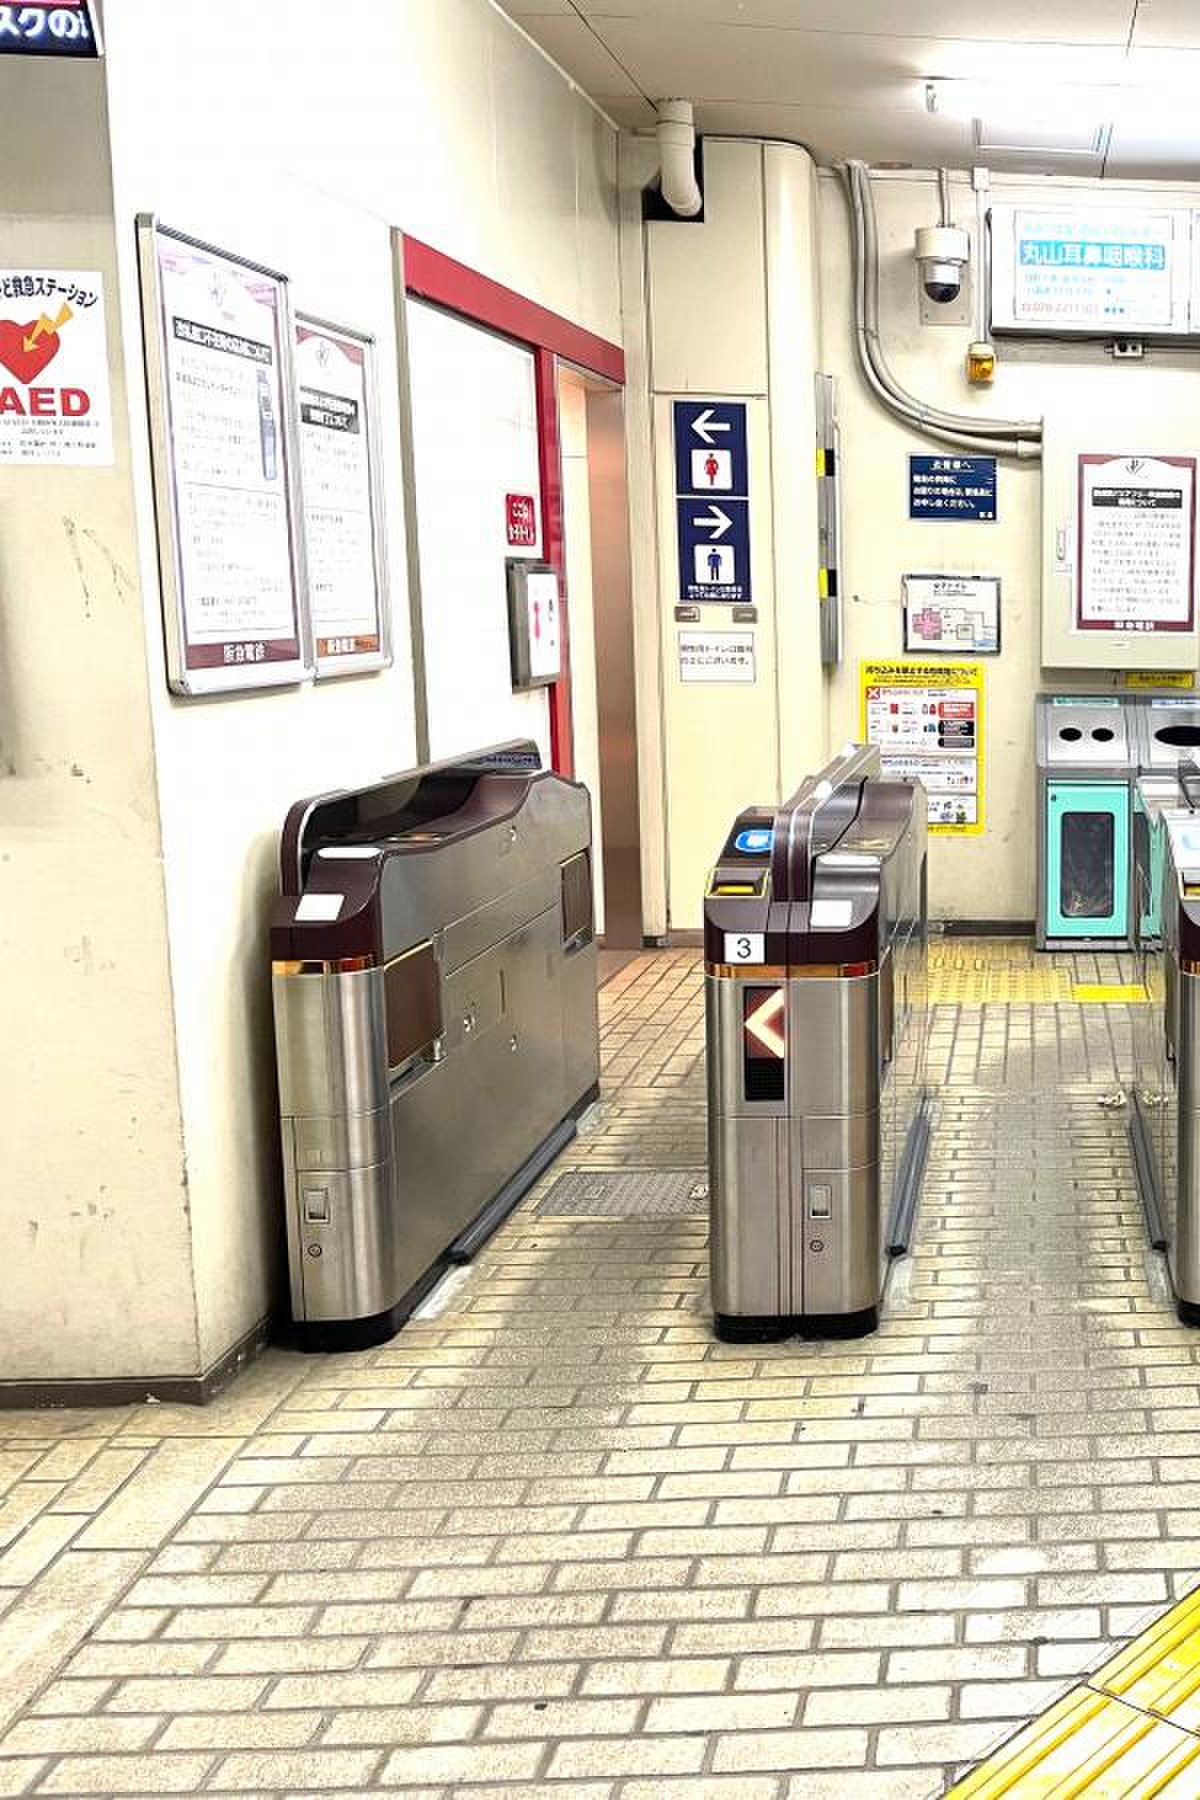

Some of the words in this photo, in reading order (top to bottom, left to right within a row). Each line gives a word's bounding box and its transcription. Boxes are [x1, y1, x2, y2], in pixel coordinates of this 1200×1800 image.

[0, 5, 89, 38] スクの
[0, 275, 98, 308] ど救急ステーション
[0, 386, 91, 417] AED
[736, 937, 751, 959] 3
